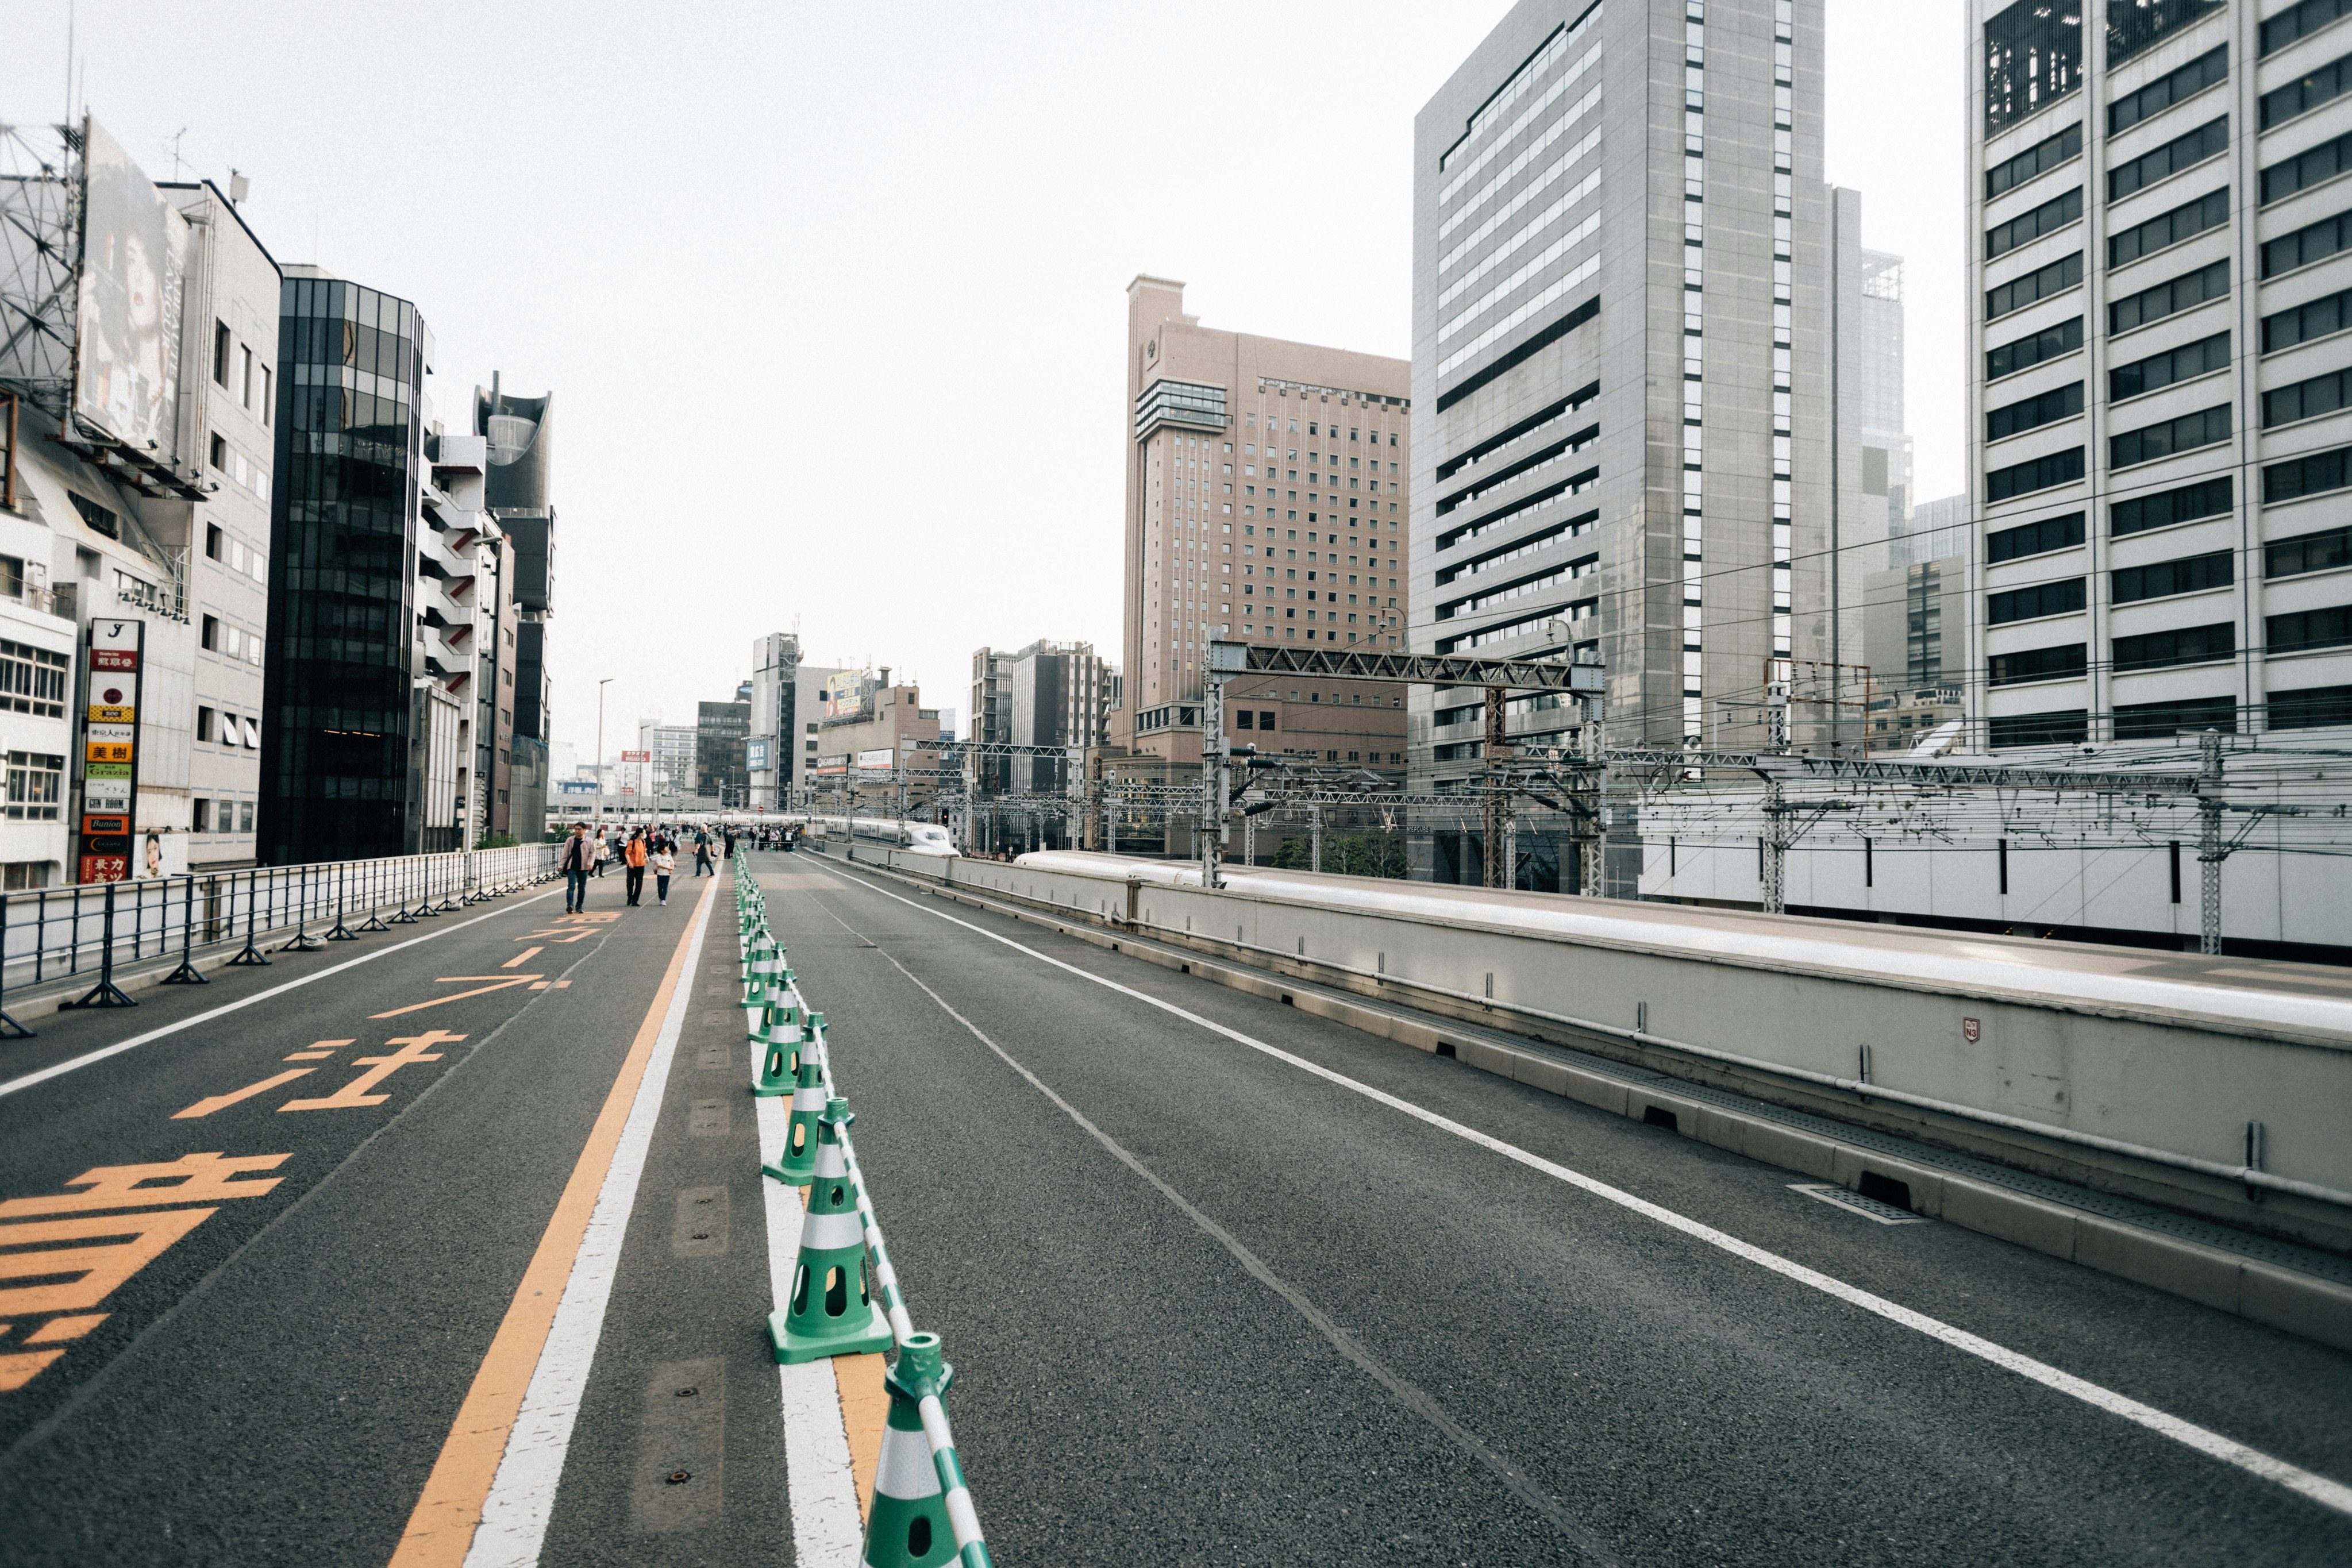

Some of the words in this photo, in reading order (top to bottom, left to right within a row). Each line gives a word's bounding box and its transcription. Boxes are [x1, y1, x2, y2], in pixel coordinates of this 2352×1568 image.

[93, 746, 127, 759] 美樹
[89, 799, 102, 808] GUN
[105, 799, 124, 809] ROOM
[92, 819, 121, 827] Bunion
[94, 858, 108, 883] 最高
[1966, 1028, 1976, 1037] N3
